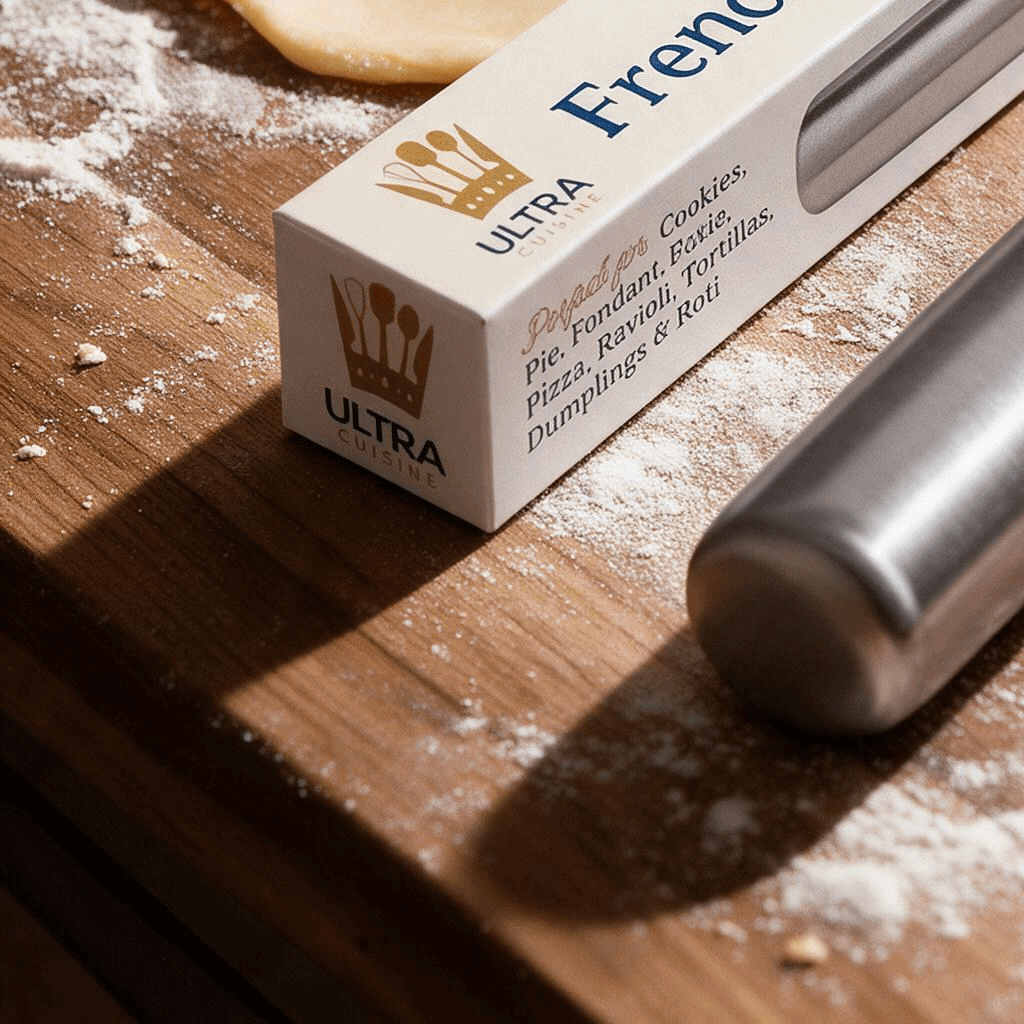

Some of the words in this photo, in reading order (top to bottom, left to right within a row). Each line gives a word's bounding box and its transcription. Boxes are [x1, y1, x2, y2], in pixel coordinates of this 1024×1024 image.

[475, 178, 595, 255] ULTRA
[518, 192, 602, 257] CUISINE
[660, 164, 747, 239] Cookies,
[597, 282, 677, 361] Ravioli,
[681, 207, 774, 288] Tortillas,
[528, 342, 647, 454] Dumplings
[653, 319, 670, 346] &
[677, 275, 721, 330] Roti
[324, 387, 447, 478] ULTRA
[337, 428, 438, 489] CUISINE
